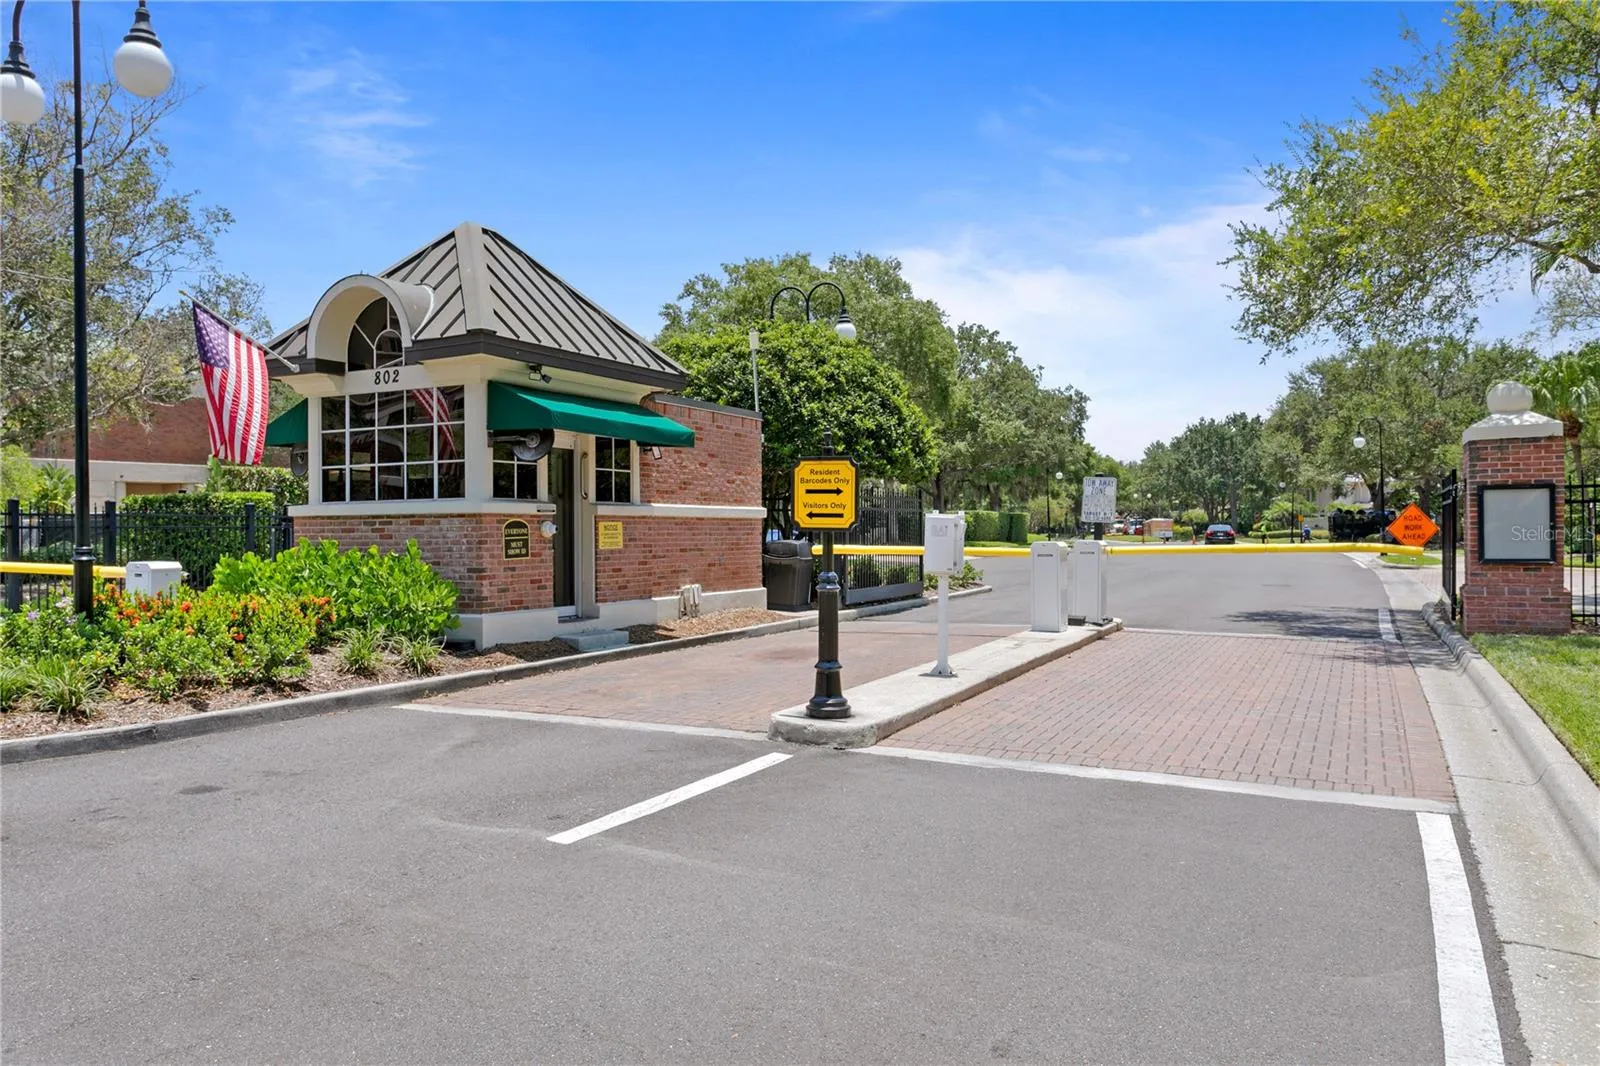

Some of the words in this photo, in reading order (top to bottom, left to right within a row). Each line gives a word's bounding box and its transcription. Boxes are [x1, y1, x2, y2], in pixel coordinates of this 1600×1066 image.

[374, 369, 400, 385] 802
[809, 468, 841, 476] Resident
[800, 477, 832, 485] Barcodes
[834, 477, 850, 486] Only
[1099, 479, 1114, 487] AWAY
[1091, 486, 1107, 496] ZONE
[830, 502, 847, 510] Only
